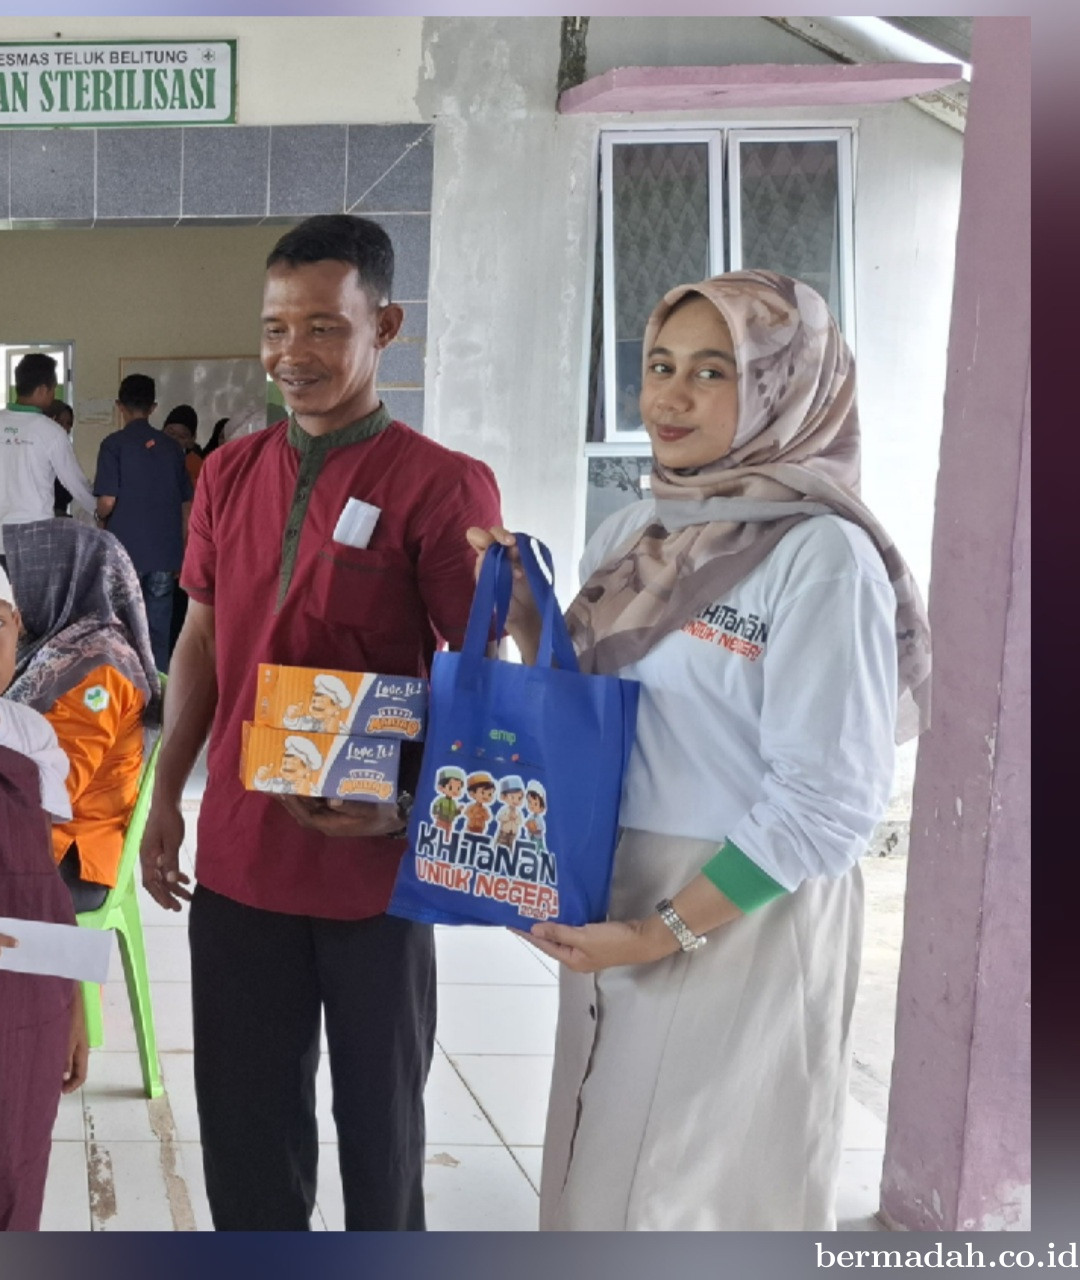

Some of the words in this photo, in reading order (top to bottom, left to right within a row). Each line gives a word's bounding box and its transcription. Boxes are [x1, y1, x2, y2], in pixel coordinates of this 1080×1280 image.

[54, 51, 105, 65] TELUK
[109, 50, 188, 65] BELITUNG
[39, 68, 217, 113] STERILISASI
[374, 680, 403, 699] Love
[489, 729, 517, 746] emp
[346, 742, 374, 760] Love
[416, 857, 471, 892] UNTUK
